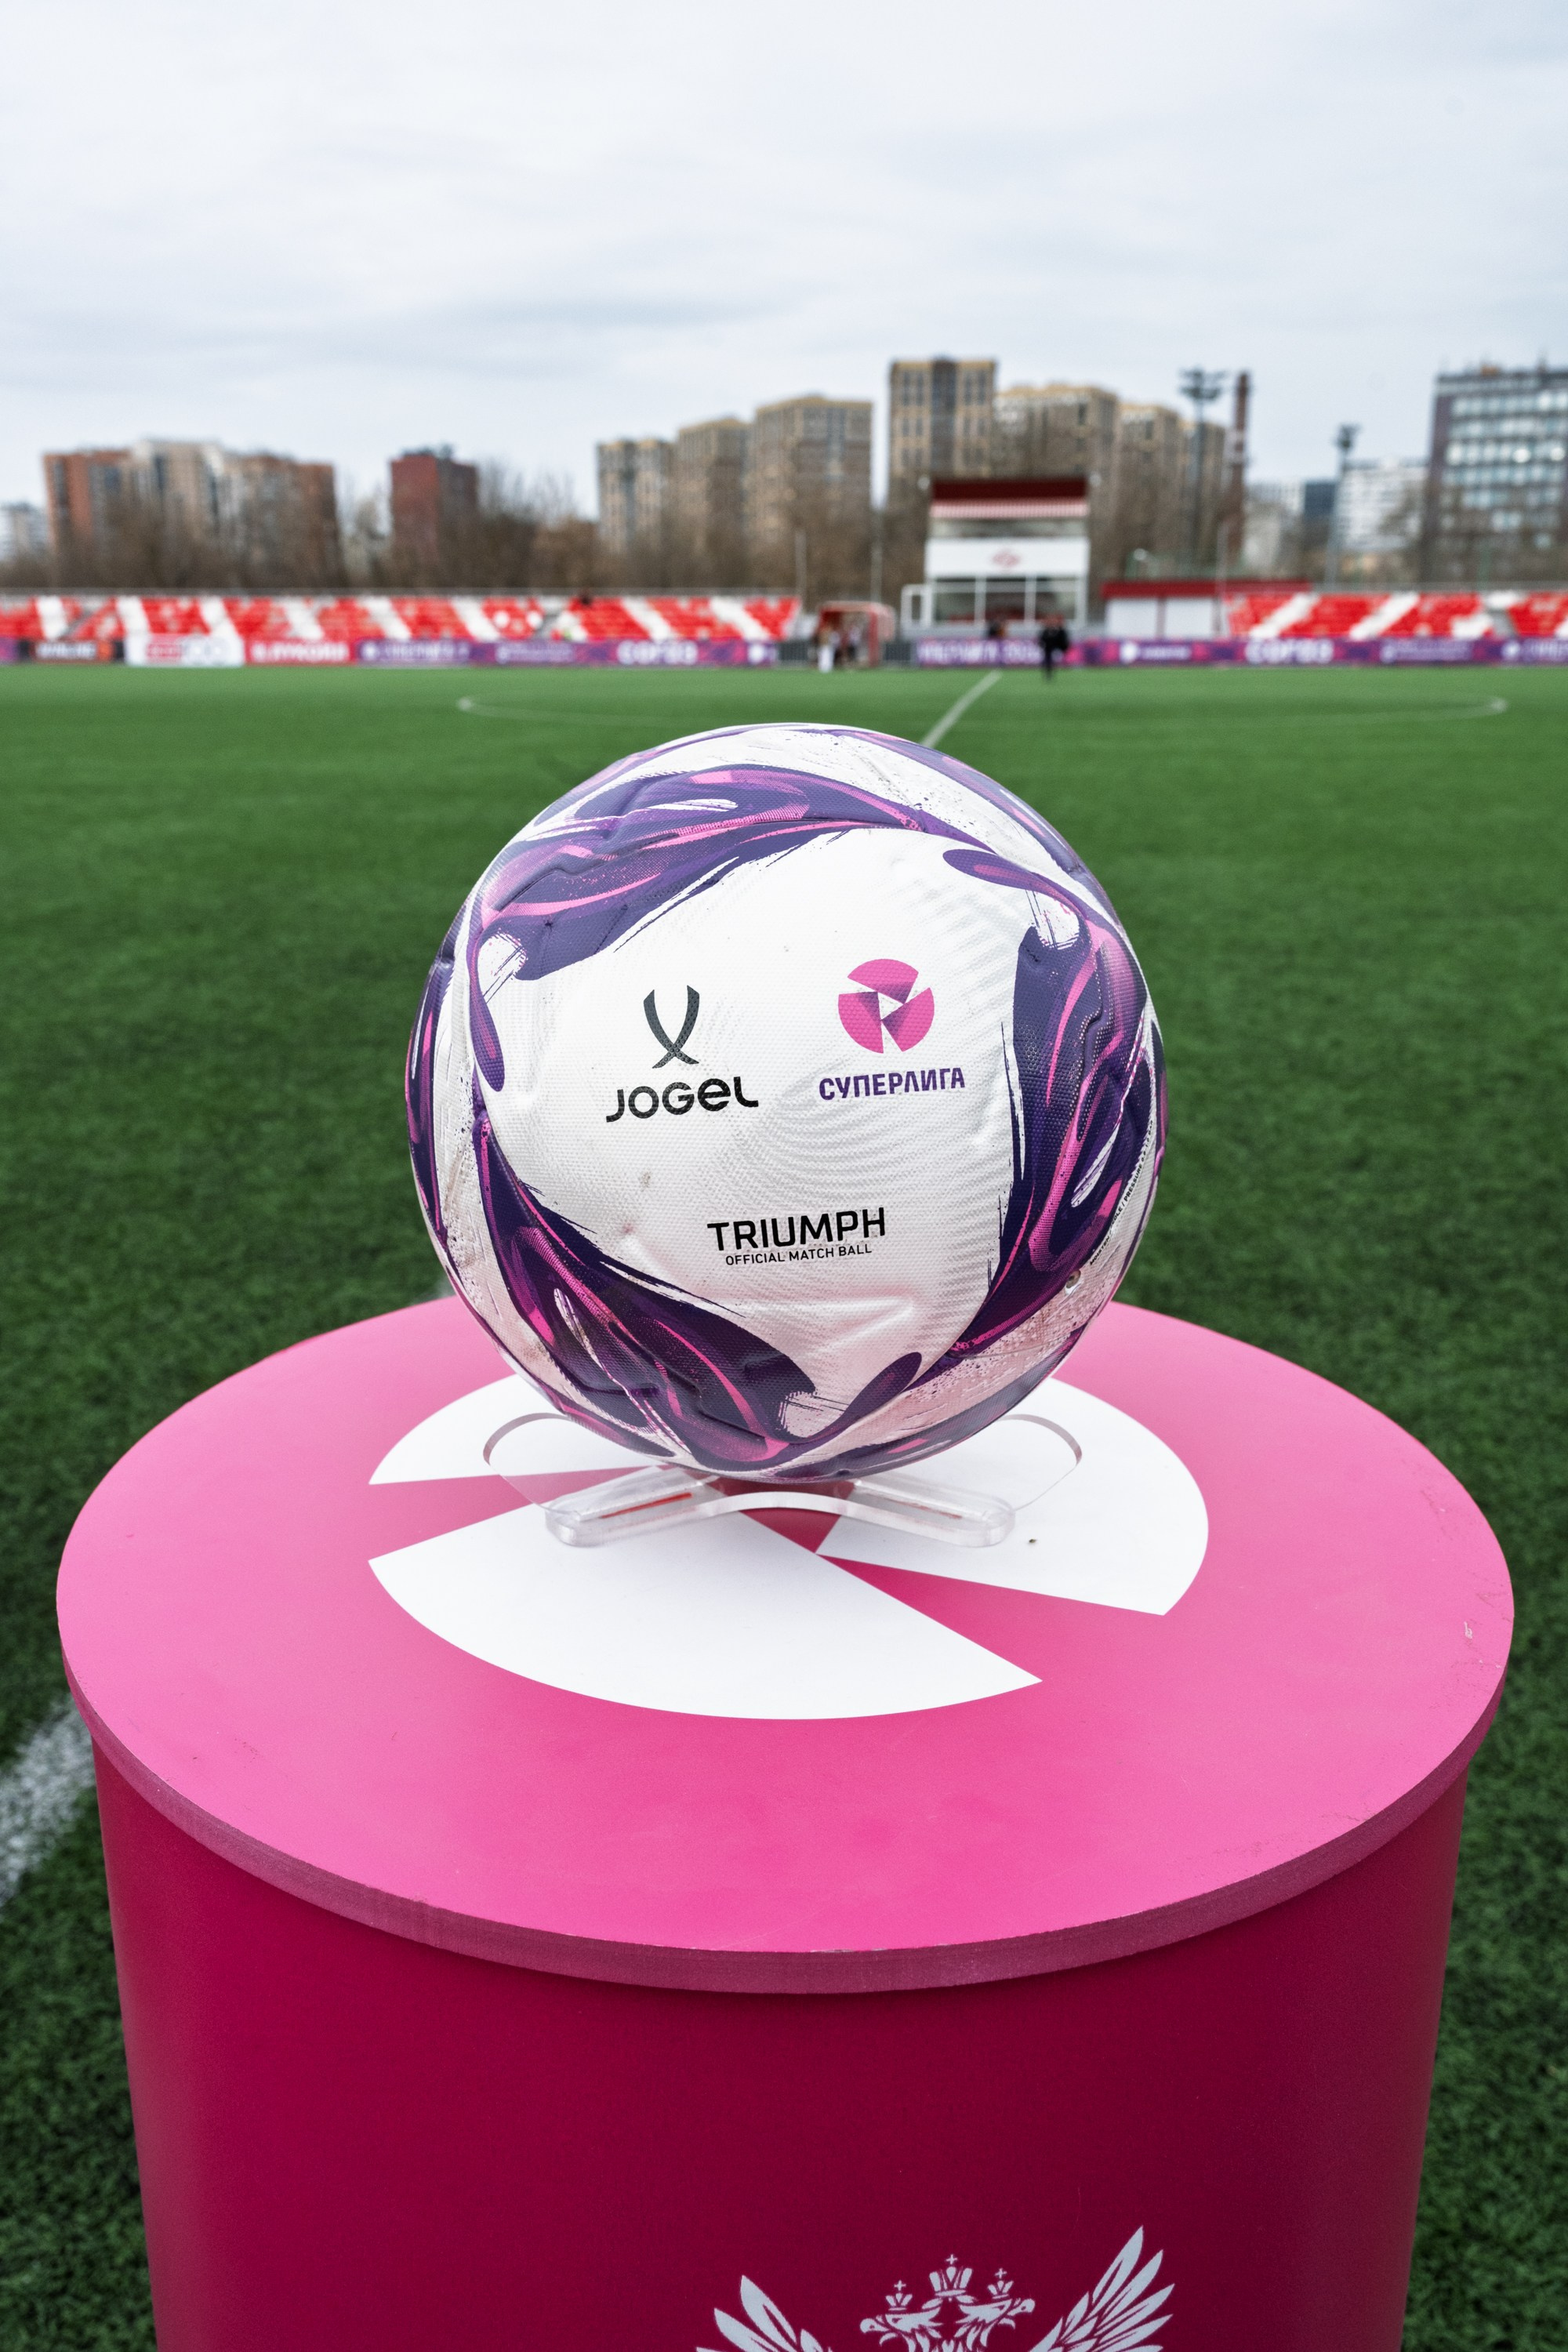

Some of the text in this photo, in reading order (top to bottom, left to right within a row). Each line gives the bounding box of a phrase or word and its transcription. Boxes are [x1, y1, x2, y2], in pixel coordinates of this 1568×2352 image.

[819, 1067, 965, 1101] СУПЕРЛИГА
[1124, 1163, 1142, 1202] PRESSURE
[707, 1207, 886, 1251] TRIUMPH
[725, 1243, 873, 1266] OFFICIAL MATCH BALL
